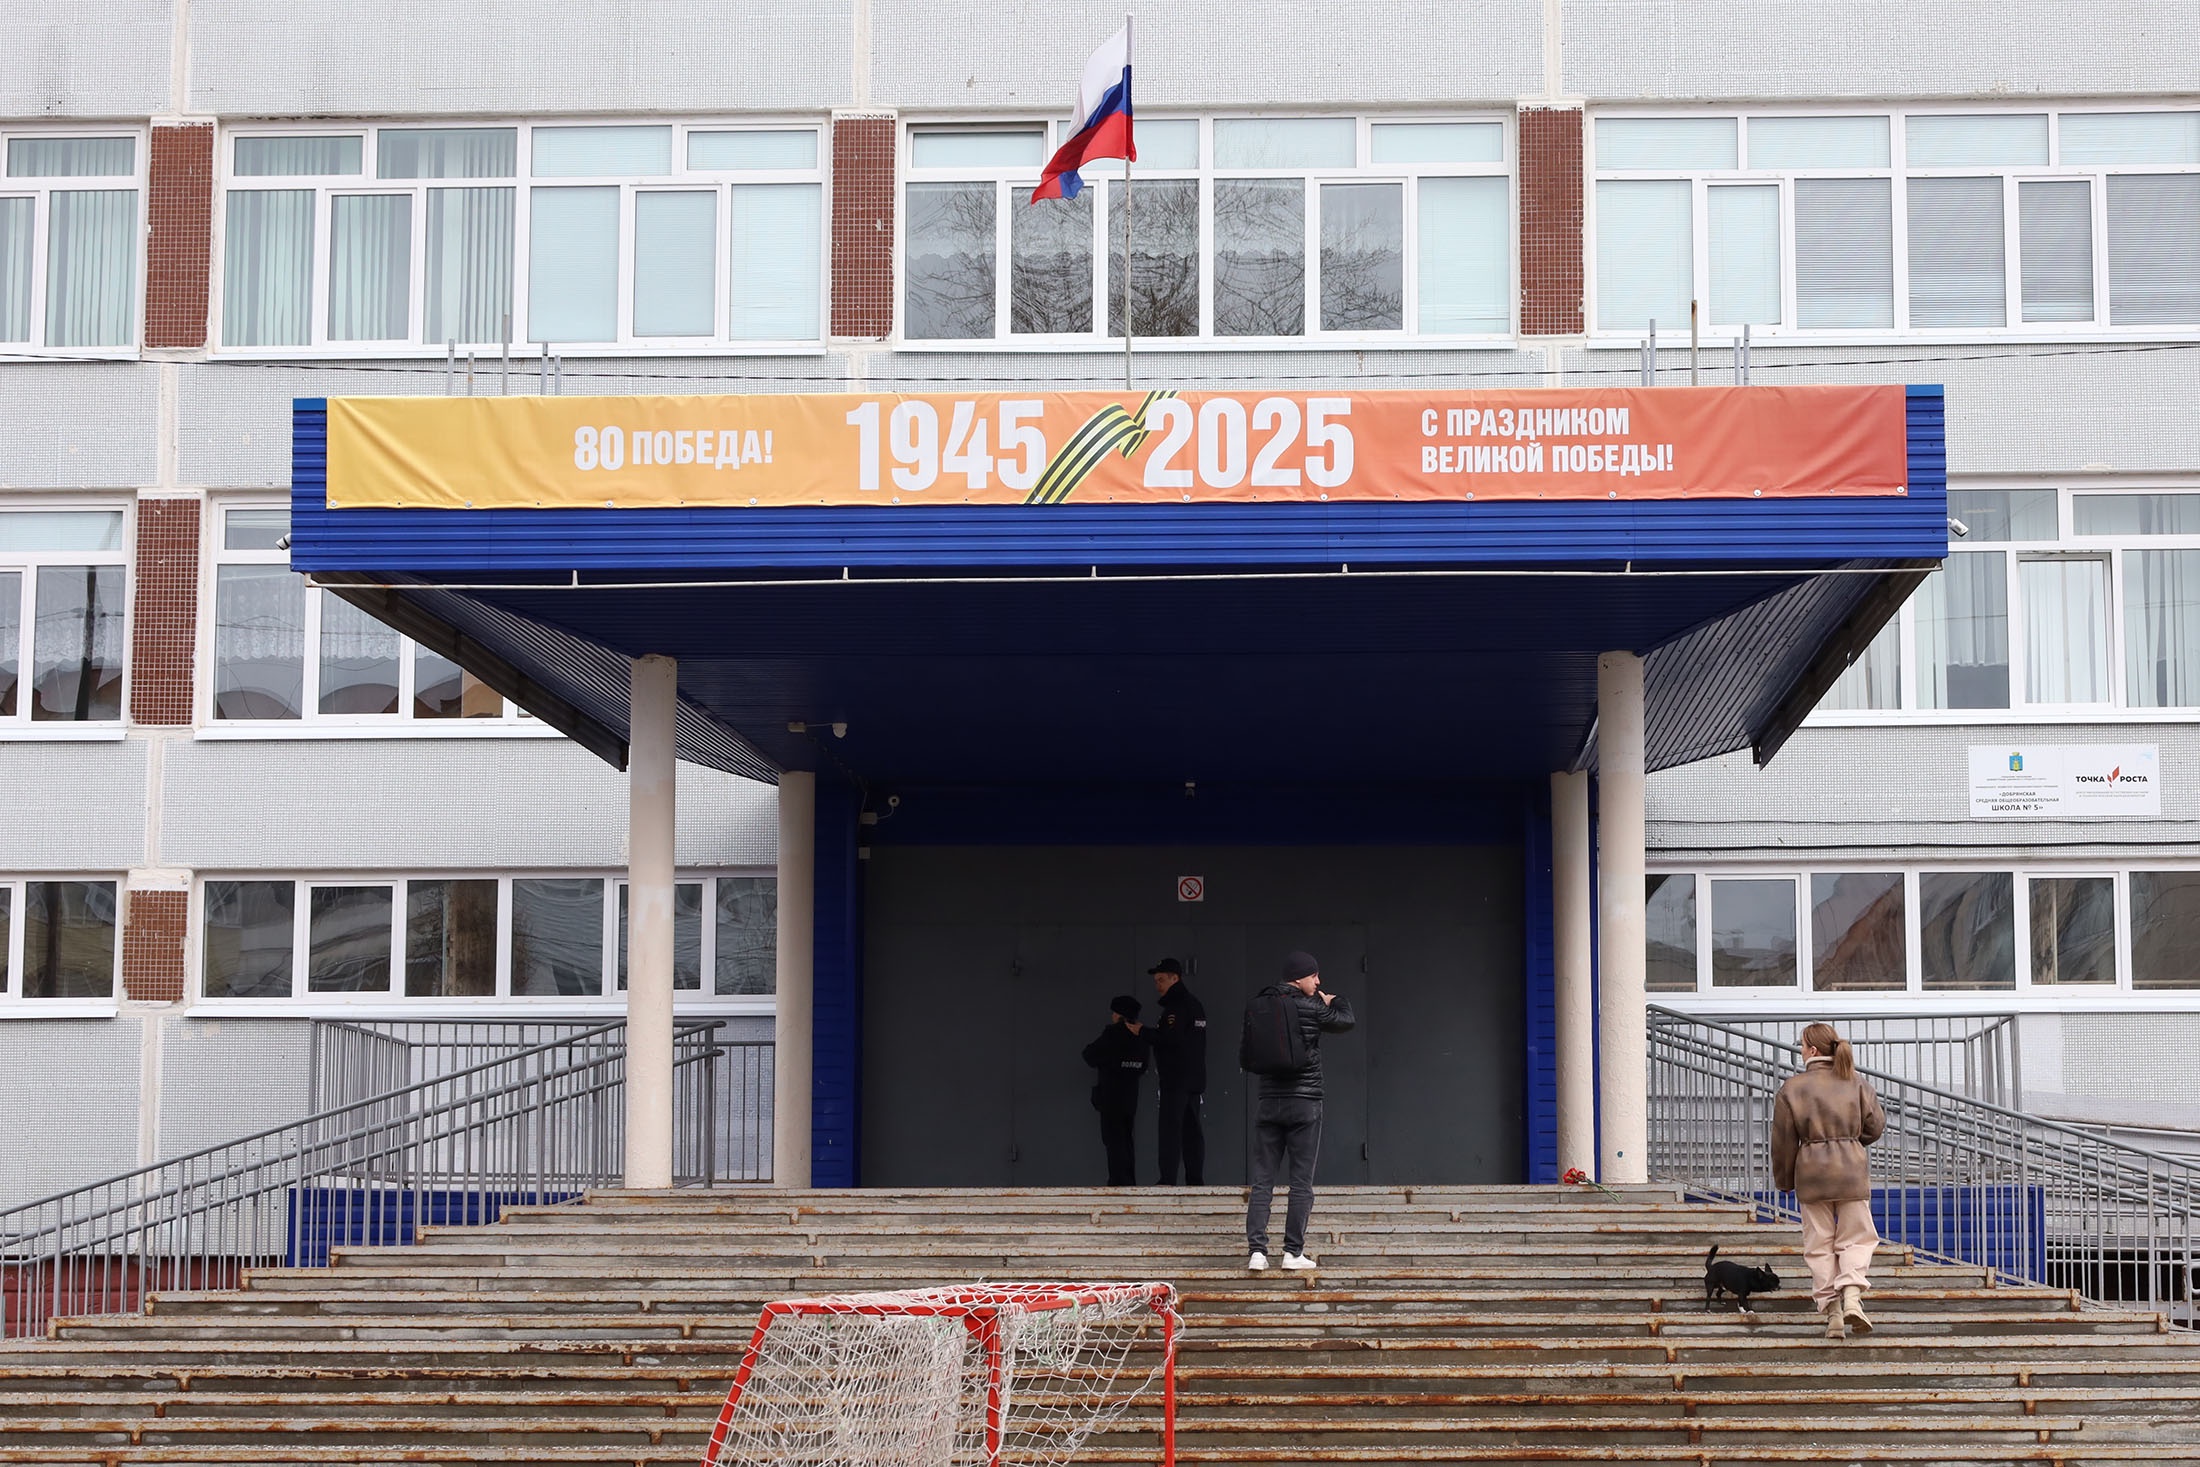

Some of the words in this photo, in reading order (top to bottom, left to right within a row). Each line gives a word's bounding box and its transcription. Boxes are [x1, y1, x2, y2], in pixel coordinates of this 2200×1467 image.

[1421, 408, 1438, 437] С
[1447, 407, 1630, 441] ПРАЗДНИКОМ
[574, 425, 625, 471] 80
[631, 429, 774, 471] ПОБЕДА!
[846, 399, 1047, 491] 1945
[1142, 396, 1354, 488] 2025
[1421, 441, 1545, 474] ВЕЛИКОЙ
[1552, 443, 1674, 477] ПОБЕДЫ!
[2075, 775, 2105, 783] ТОЧКА
[2119, 775, 2148, 783] РОСТА
